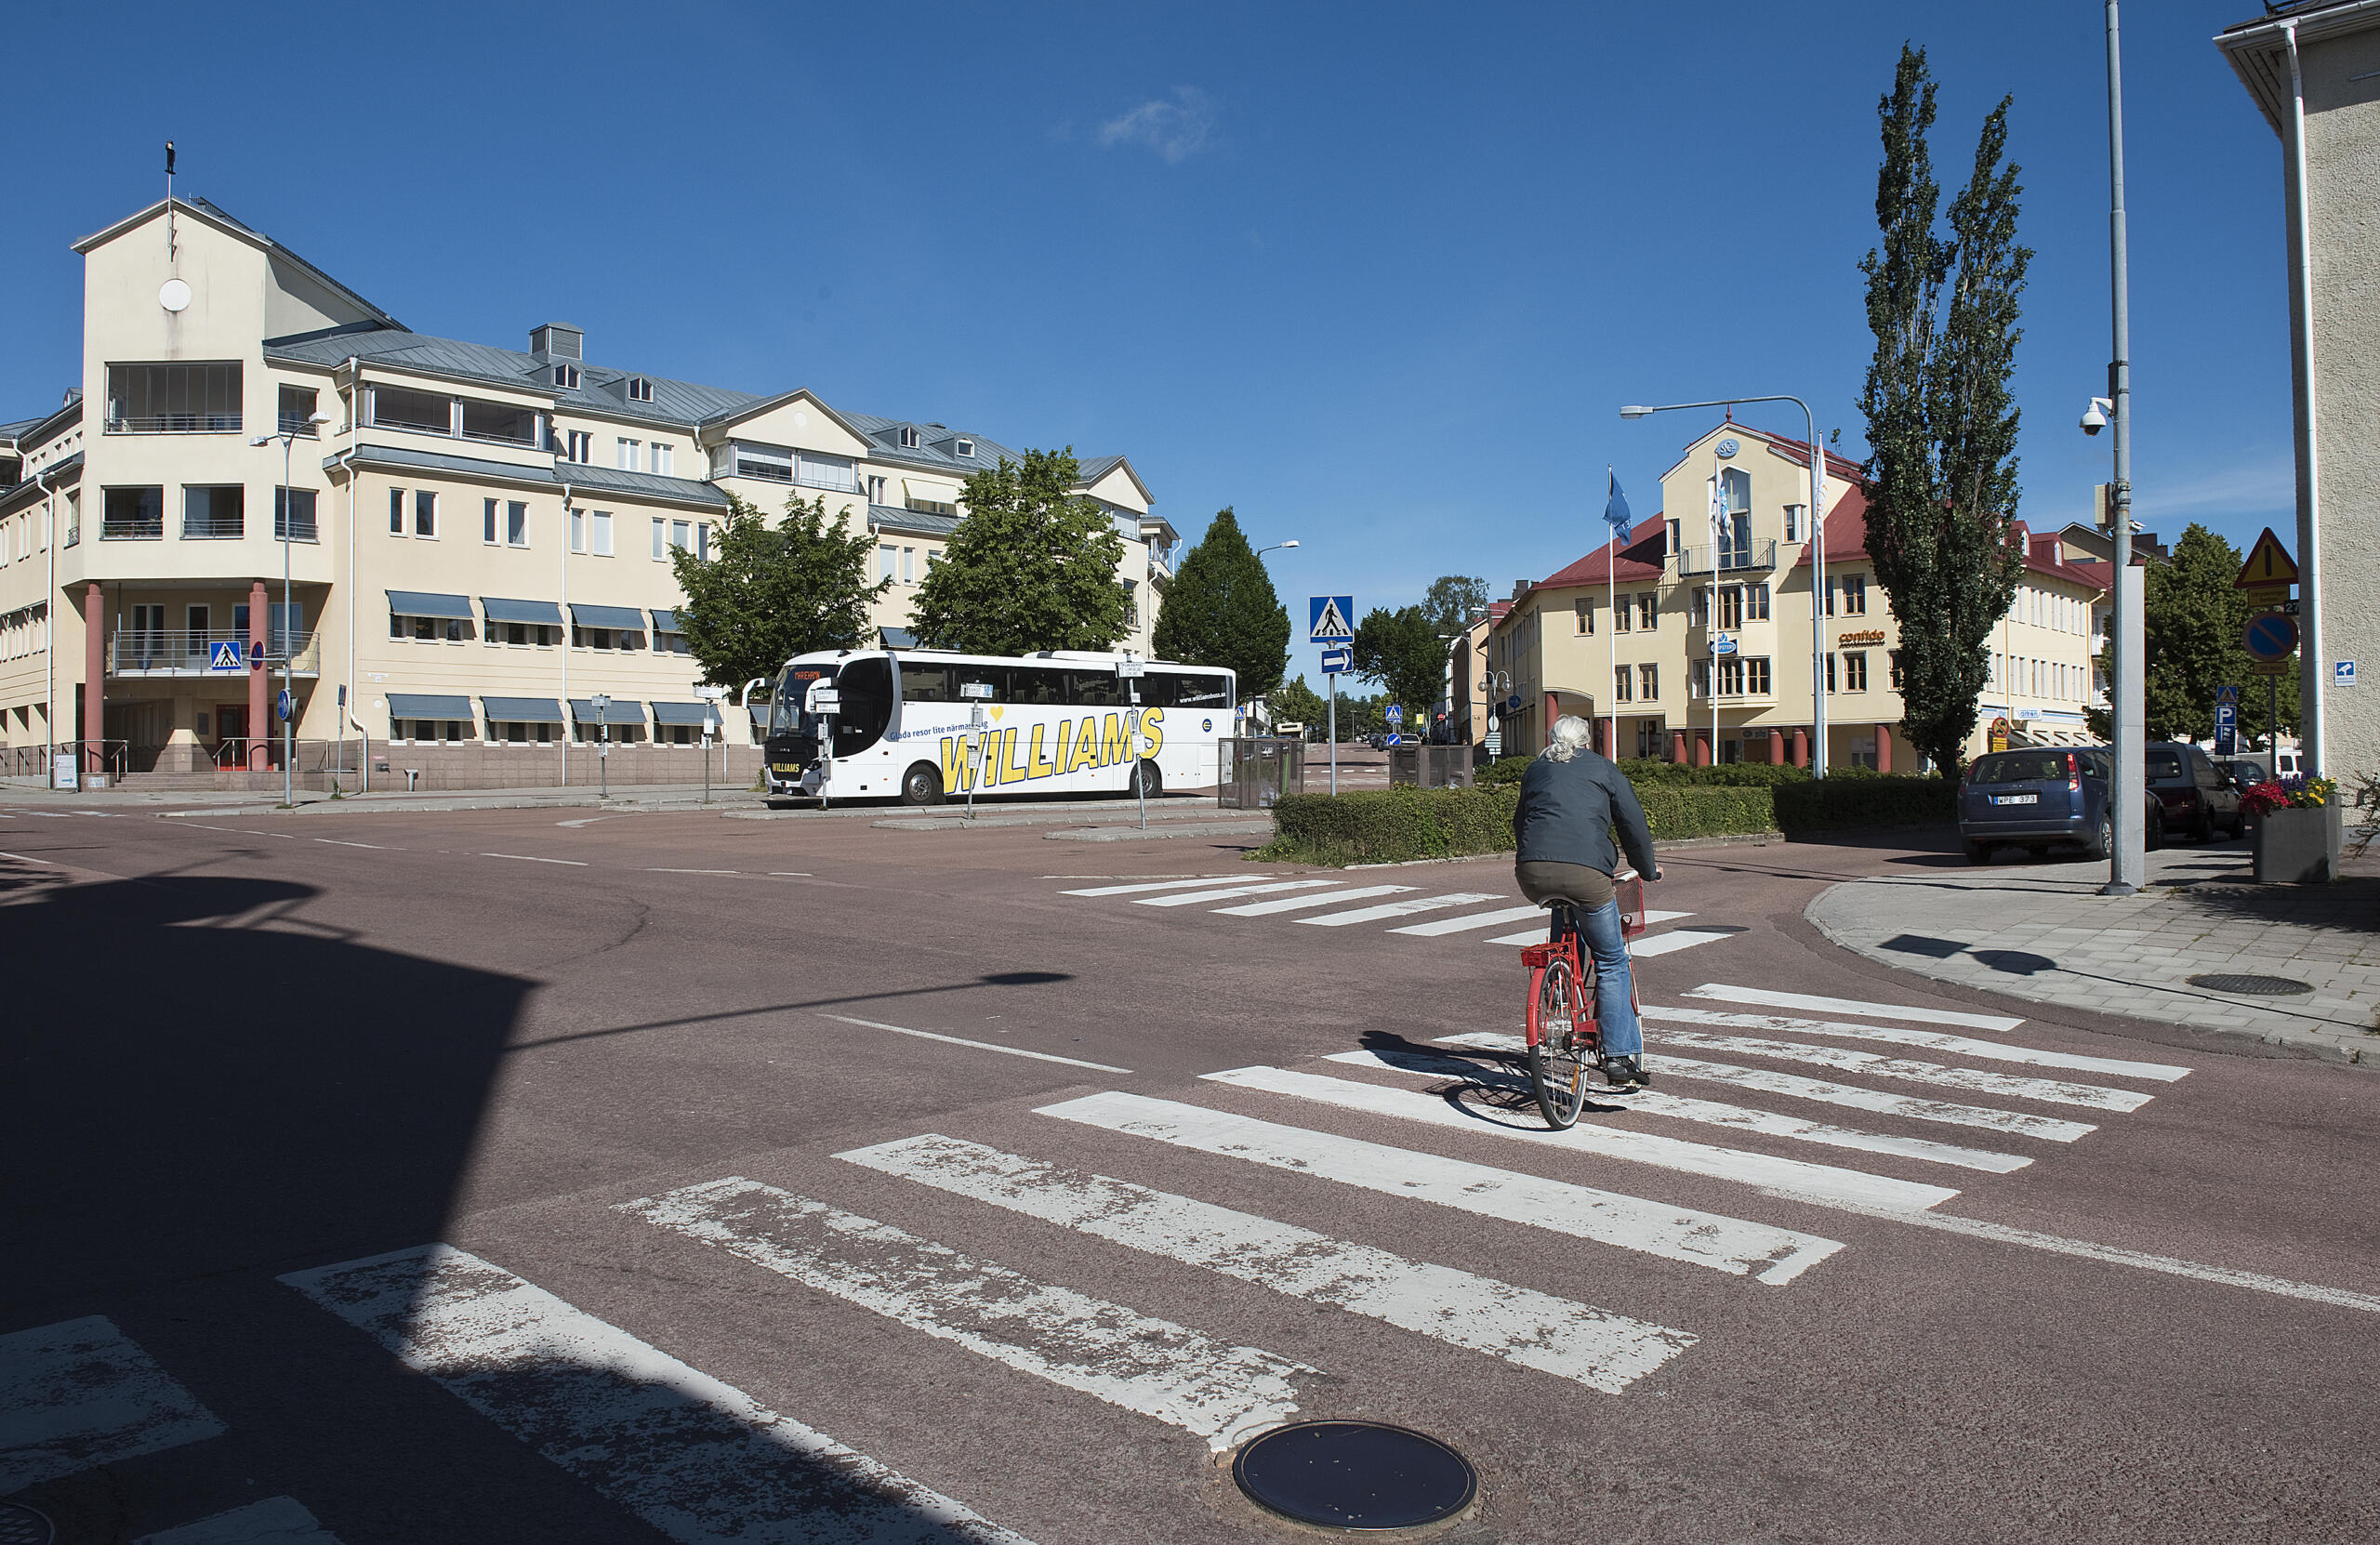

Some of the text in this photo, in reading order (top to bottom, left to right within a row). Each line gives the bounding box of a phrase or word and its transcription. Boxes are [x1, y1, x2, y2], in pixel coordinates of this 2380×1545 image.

[1838, 628, 1885, 642] confido
[2219, 707, 2232, 723] P
[890, 731, 911, 741] Glada
[912, 729, 931, 737] resor
[932, 726, 945, 734] lite
[946, 723, 973, 733] närmar
[940, 706, 1165, 795] WILLIAMS
[772, 762, 800, 773] WILLIAMS
